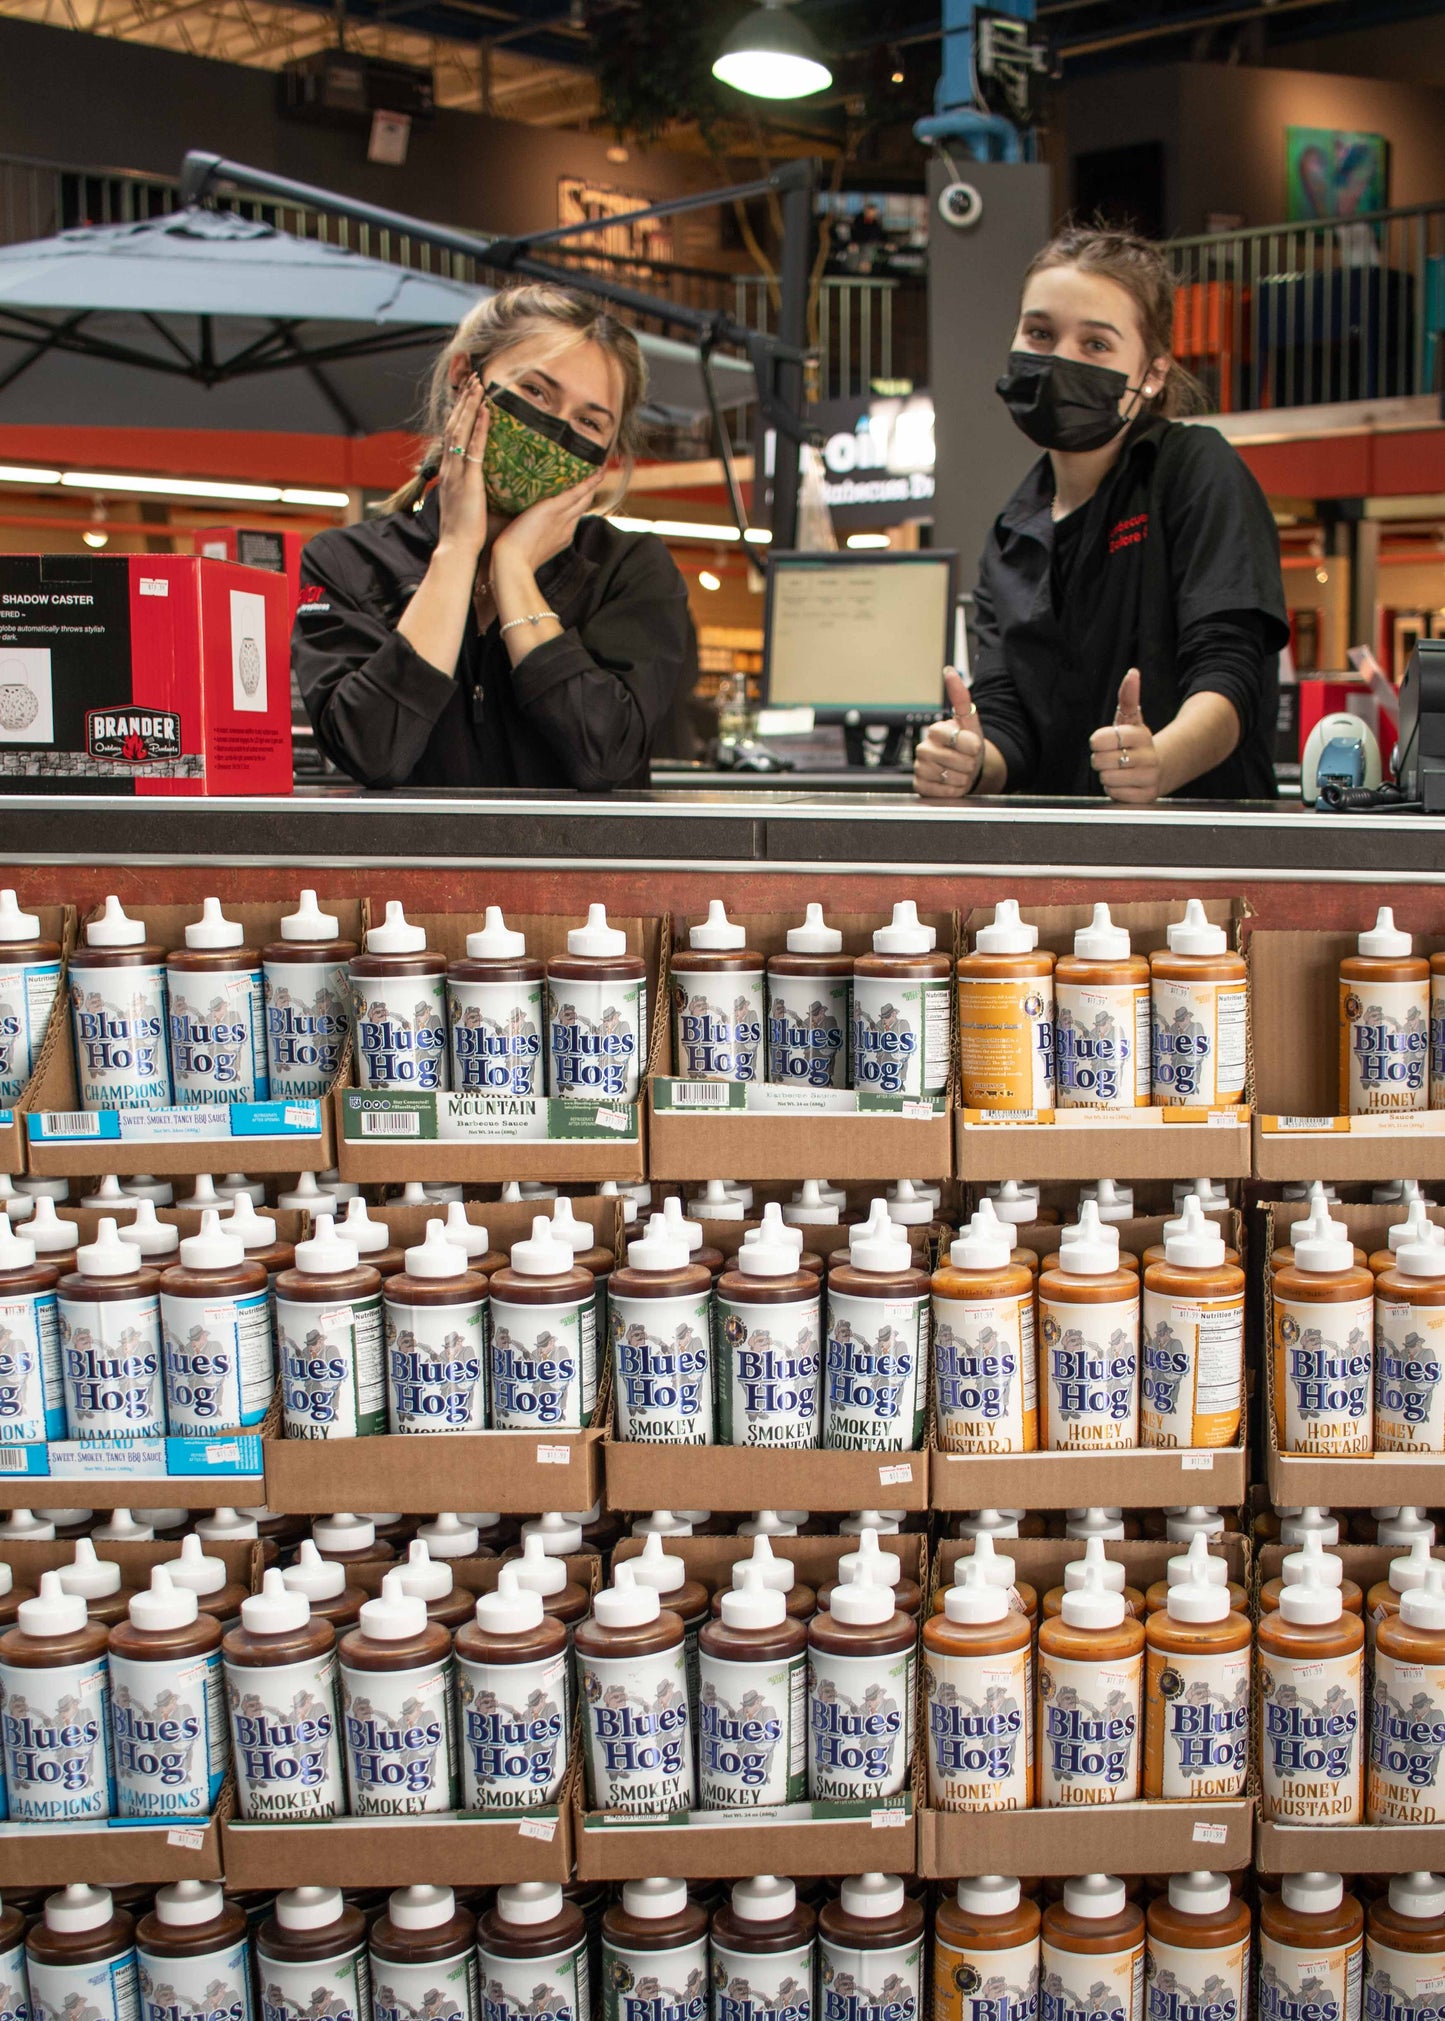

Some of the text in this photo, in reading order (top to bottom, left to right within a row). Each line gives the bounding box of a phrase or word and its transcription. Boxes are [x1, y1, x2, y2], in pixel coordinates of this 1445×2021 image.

[2, 595, 93, 605] SHADOW CASTER
[17, 625, 59, 634] automatically
[85, 626, 105, 634] stylish
[94, 716, 175, 740] BRANDER
[79, 1012, 161, 1039] Blues
[170, 1013, 246, 1043] Blues
[269, 1007, 348, 1035] Blues
[360, 1021, 446, 1050] Blues
[681, 1014, 761, 1042] Blues
[768, 1017, 842, 1048] Blues
[1354, 1024, 1428, 1051] Blues
[274, 1037, 341, 1074] Hog
[454, 1026, 540, 1057] Blues
[551, 1023, 634, 1055] Blues
[1056, 1026, 1129, 1058] Blues
[87, 1043, 155, 1076] Hog
[175, 1045, 236, 1082] Hog
[367, 1052, 440, 1089] Hog
[462, 1057, 530, 1094] Hog
[555, 1056, 626, 1095] Hog
[687, 1045, 753, 1080] Hog
[772, 1049, 830, 1086] Hog
[1360, 1054, 1422, 1088] Hog
[84, 1080, 167, 1100] CHAMPIONS'
[1058, 1060, 1116, 1097] Hog
[448, 1100, 536, 1116] MOUNTAIN
[1369, 1091, 1416, 1107] HONEY
[147, 1115, 172, 1125] SMOKEY,
[194, 1114, 207, 1124] BBQ
[208, 1114, 227, 1123] SAUCE
[1201, 1311, 1231, 1320] Nutrition
[65, 1348, 157, 1379] Blues
[390, 1349, 479, 1383] Blues
[492, 1347, 574, 1382] Blues
[618, 1344, 707, 1375] Blues
[737, 1350, 819, 1381] Blues
[828, 1338, 912, 1375] Blues
[936, 1345, 1016, 1377] Blues
[1052, 1349, 1136, 1381] Blues
[1290, 1349, 1371, 1380] Blues
[73, 1382, 150, 1418] Hog
[396, 1383, 469, 1423] Hog
[495, 1381, 562, 1421] Hog
[626, 1377, 699, 1415] Hog
[745, 1383, 816, 1418] Hog
[830, 1374, 897, 1416] Hog
[939, 1377, 1004, 1418] Hog
[1059, 1382, 1128, 1420] Hog
[1298, 1381, 1365, 1418] Hog
[629, 1419, 695, 1436] SMOKEY
[748, 1422, 812, 1441] SMOKEY
[830, 1413, 893, 1436] SMOKEY
[945, 1420, 996, 1436] HONEY
[1069, 1423, 1122, 1440] HONEY
[1307, 1420, 1359, 1439] HONEY
[78, 1452, 104, 1462] SMOKEY,
[128, 1452, 141, 1463] BBQ
[142, 1452, 162, 1462] SAUCE
[826, 1432, 902, 1451] MOUNTAIN
[1294, 1435, 1368, 1454] MUSTARD
[4, 1713, 99, 1750] Blues
[113, 1702, 200, 1742] Blues
[234, 1713, 332, 1748] Blues
[466, 1711, 561, 1745] Blues
[594, 1702, 686, 1738] Blues
[811, 1697, 900, 1734] Blues
[930, 1701, 1022, 1737] Blues
[1046, 1704, 1135, 1741] Blues
[1266, 1702, 1357, 1738] Blues
[1371, 1702, 1445, 1744] Blues
[349, 1716, 441, 1751] Blues
[12, 1751, 90, 1790] Hog
[118, 1738, 187, 1784] Hog
[245, 1748, 323, 1786] Hog
[474, 1744, 551, 1784] Hog
[604, 1739, 683, 1773] Hog
[701, 1740, 766, 1785] Hog
[817, 1736, 888, 1777] Hog
[938, 1738, 1011, 1779] Hog
[1052, 1742, 1126, 1783] Hog
[1179, 1736, 1246, 1773] Hog
[1272, 1737, 1349, 1778] Hog
[1371, 1734, 1433, 1786] Hog
[355, 1753, 429, 1792] Hog
[610, 1776, 681, 1800] SMOKEY
[816, 1775, 883, 1798] SMOKEY
[1191, 1774, 1243, 1797] HONEY
[1282, 1780, 1340, 1798] HONEY
[250, 1788, 321, 1810] SMOKEY
[358, 1795, 427, 1815] SMOKEY
[476, 1786, 548, 1808] SMOKEY
[701, 1778, 761, 1805] SMOKEY
[945, 1781, 1004, 1799] HONEY
[1060, 1785, 1118, 1803] HONEY
[1270, 1796, 1352, 1817] MUSTARD
[1372, 1776, 1421, 1804] HONEY
[825, 1989, 916, 2021] Blues
[1149, 1985, 1237, 2021] Blues
